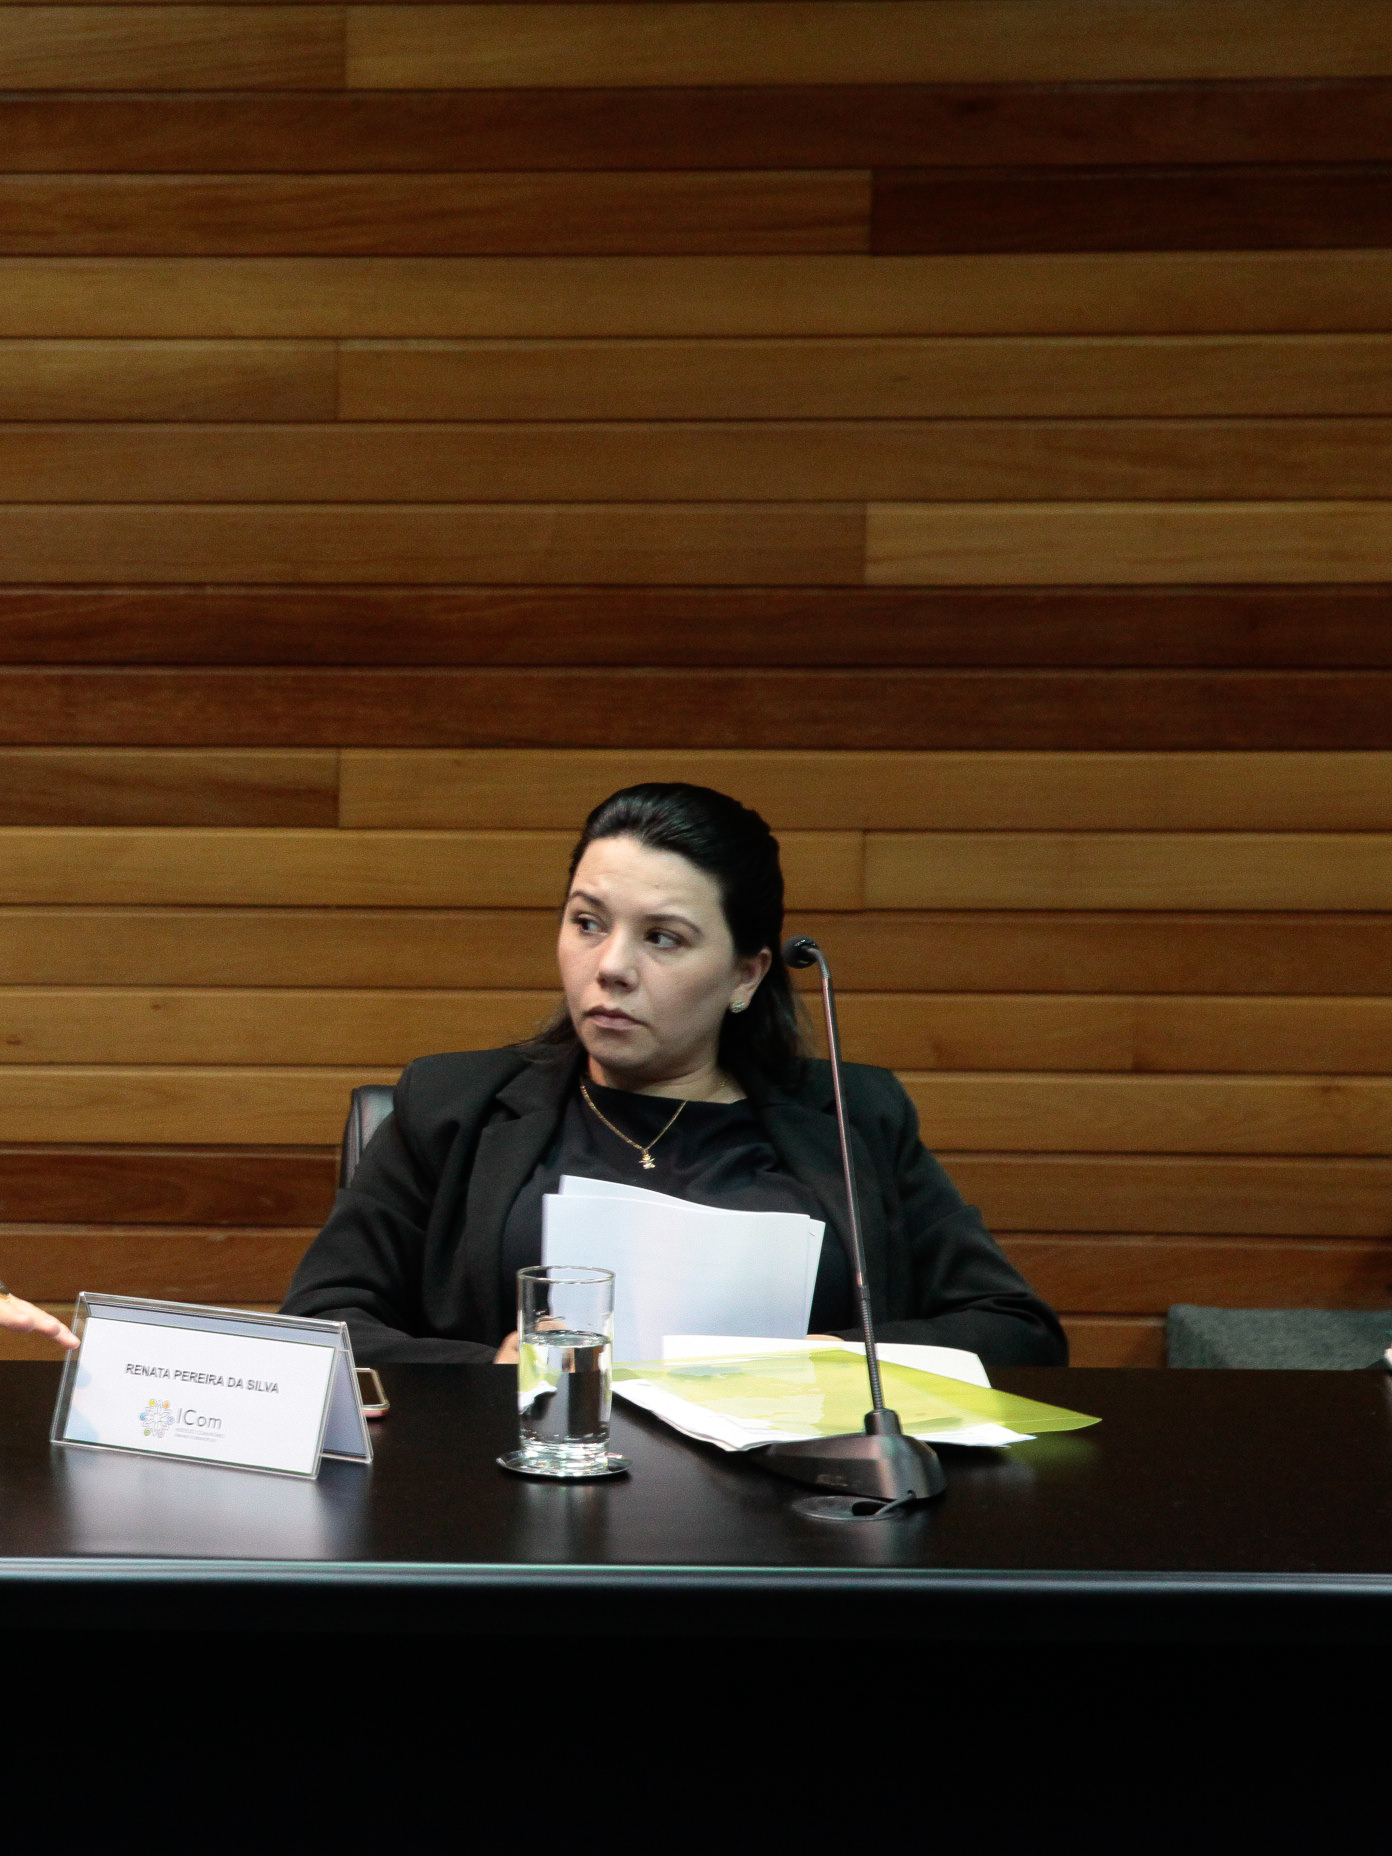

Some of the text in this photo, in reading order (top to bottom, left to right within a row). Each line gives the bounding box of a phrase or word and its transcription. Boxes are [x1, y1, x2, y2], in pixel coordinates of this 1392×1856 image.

[125, 1363, 280, 1394] RENATA PEREIRA DA SILVA
[176, 1408, 223, 1430] ICom
